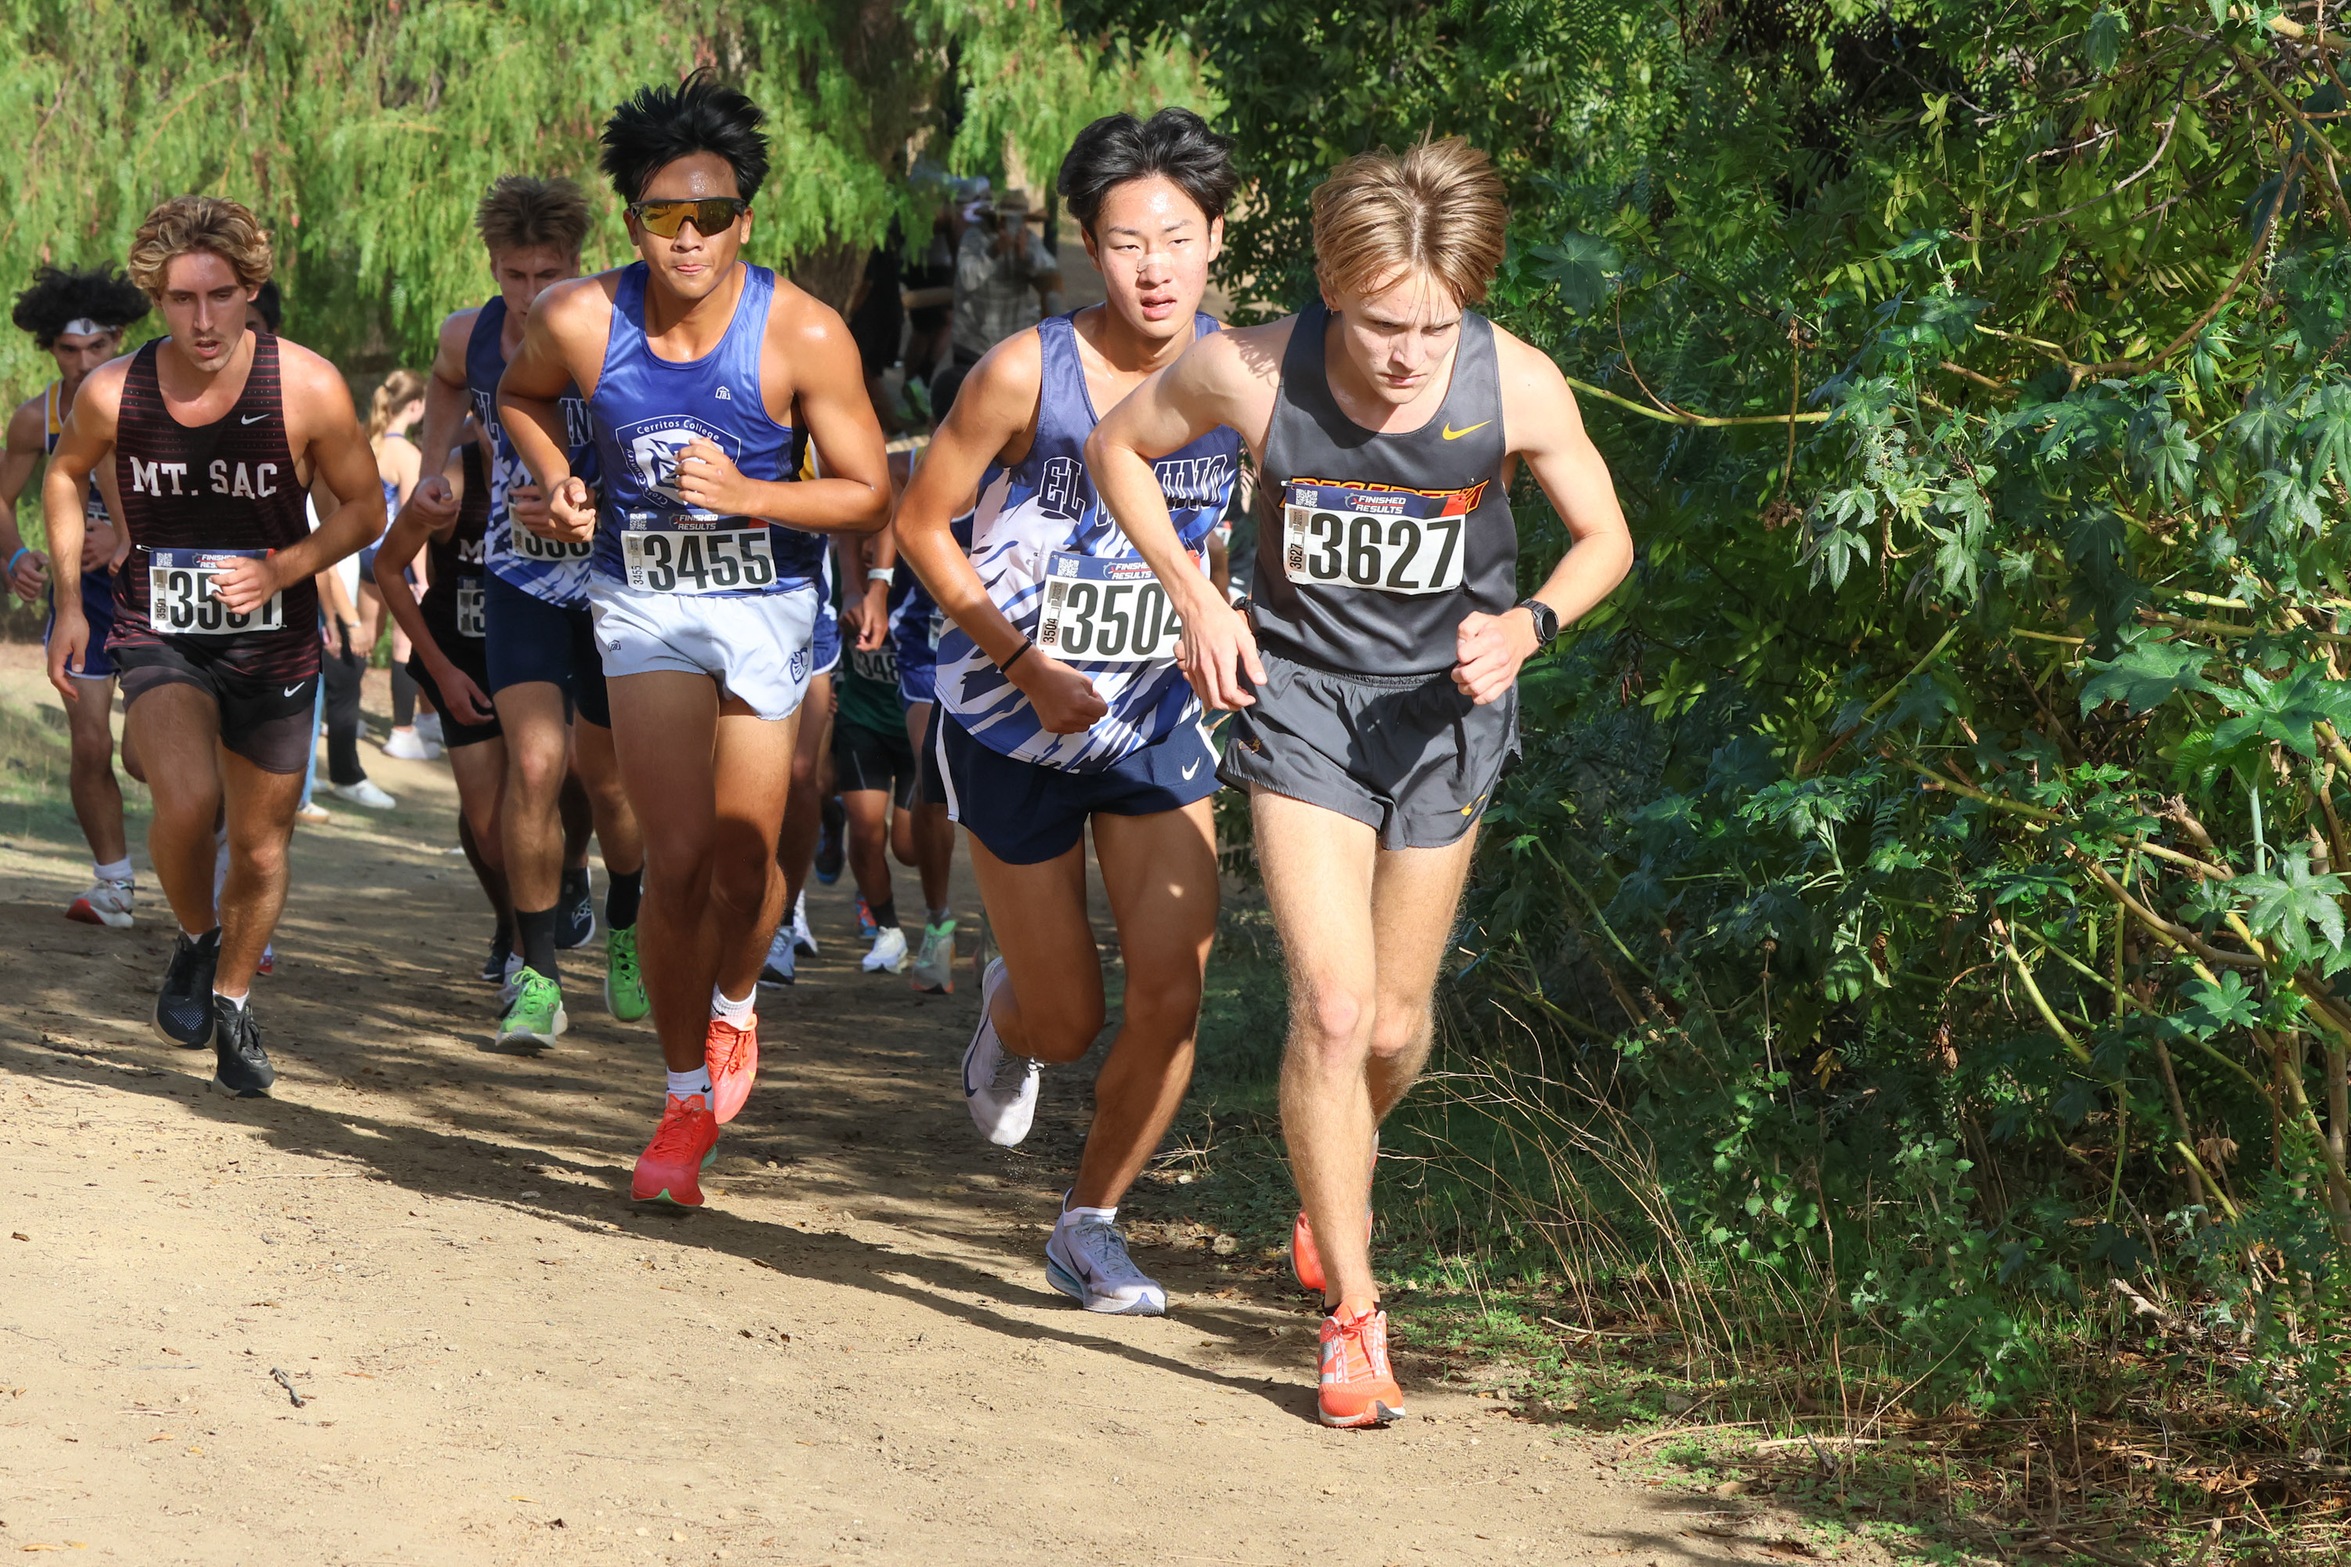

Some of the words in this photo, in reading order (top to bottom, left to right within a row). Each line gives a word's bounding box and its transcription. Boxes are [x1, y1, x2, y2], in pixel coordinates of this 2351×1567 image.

[637, 420, 680, 435] Cerritos
[683, 420, 720, 441] College
[626, 448, 646, 485] Country
[130, 456, 199, 497] MT.
[209, 459, 278, 499] SAC
[645, 487, 668, 505] Cross
[1037, 456, 1086, 525] EL
[1358, 495, 1406, 505] FINISHED
[680, 514, 719, 522] FINISHED
[1355, 504, 1404, 514] RESULTS
[678, 522, 717, 531] RESULTS
[1290, 543, 1303, 569] 3627
[1308, 512, 1462, 589] 3627
[643, 532, 772, 591] 3455
[1115, 562, 1151, 571] FINISHE
[633, 565, 644, 585] 3455
[1112, 571, 1152, 580] RESULTS
[1043, 617, 1058, 643] 3504
